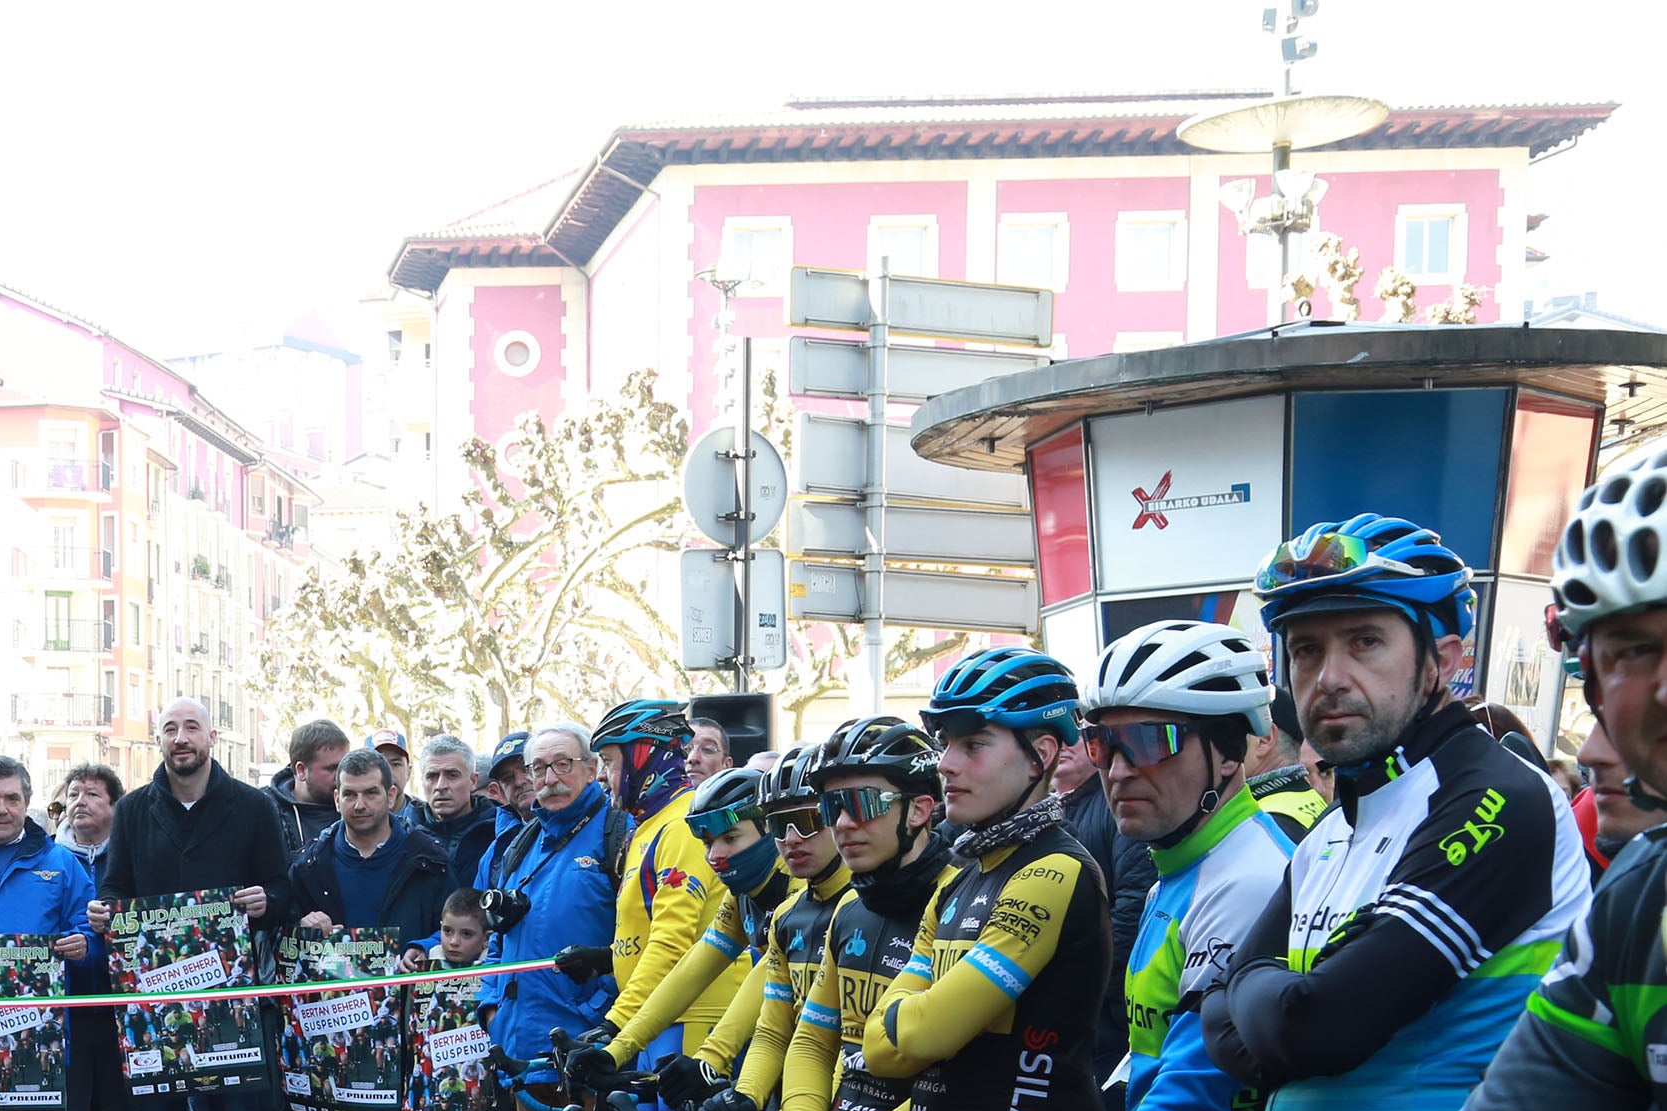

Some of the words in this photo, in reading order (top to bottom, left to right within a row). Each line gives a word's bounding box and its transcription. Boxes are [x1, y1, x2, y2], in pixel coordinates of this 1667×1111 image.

[1148, 500, 1199, 511] EIBARKO
[1201, 495, 1239, 505] UDALA
[1047, 707, 1065, 718] ABUS
[111, 912, 139, 934] 45
[142, 902, 231, 922] UDABERRI
[125, 943, 134, 958] 5
[299, 940, 384, 955] UDABERRI
[145, 970, 180, 987] BERTAN
[183, 956, 218, 974] BEHERA
[286, 968, 294, 983] 5
[301, 1006, 330, 1019] BERTAN
[333, 998, 367, 1014] BEHERA
[419, 1003, 429, 1019] 5
[304, 1011, 369, 1032] SUSPENDIDO
[433, 1032, 467, 1049] BERTAN
[208, 1052, 259, 1062] PNEUMAX
